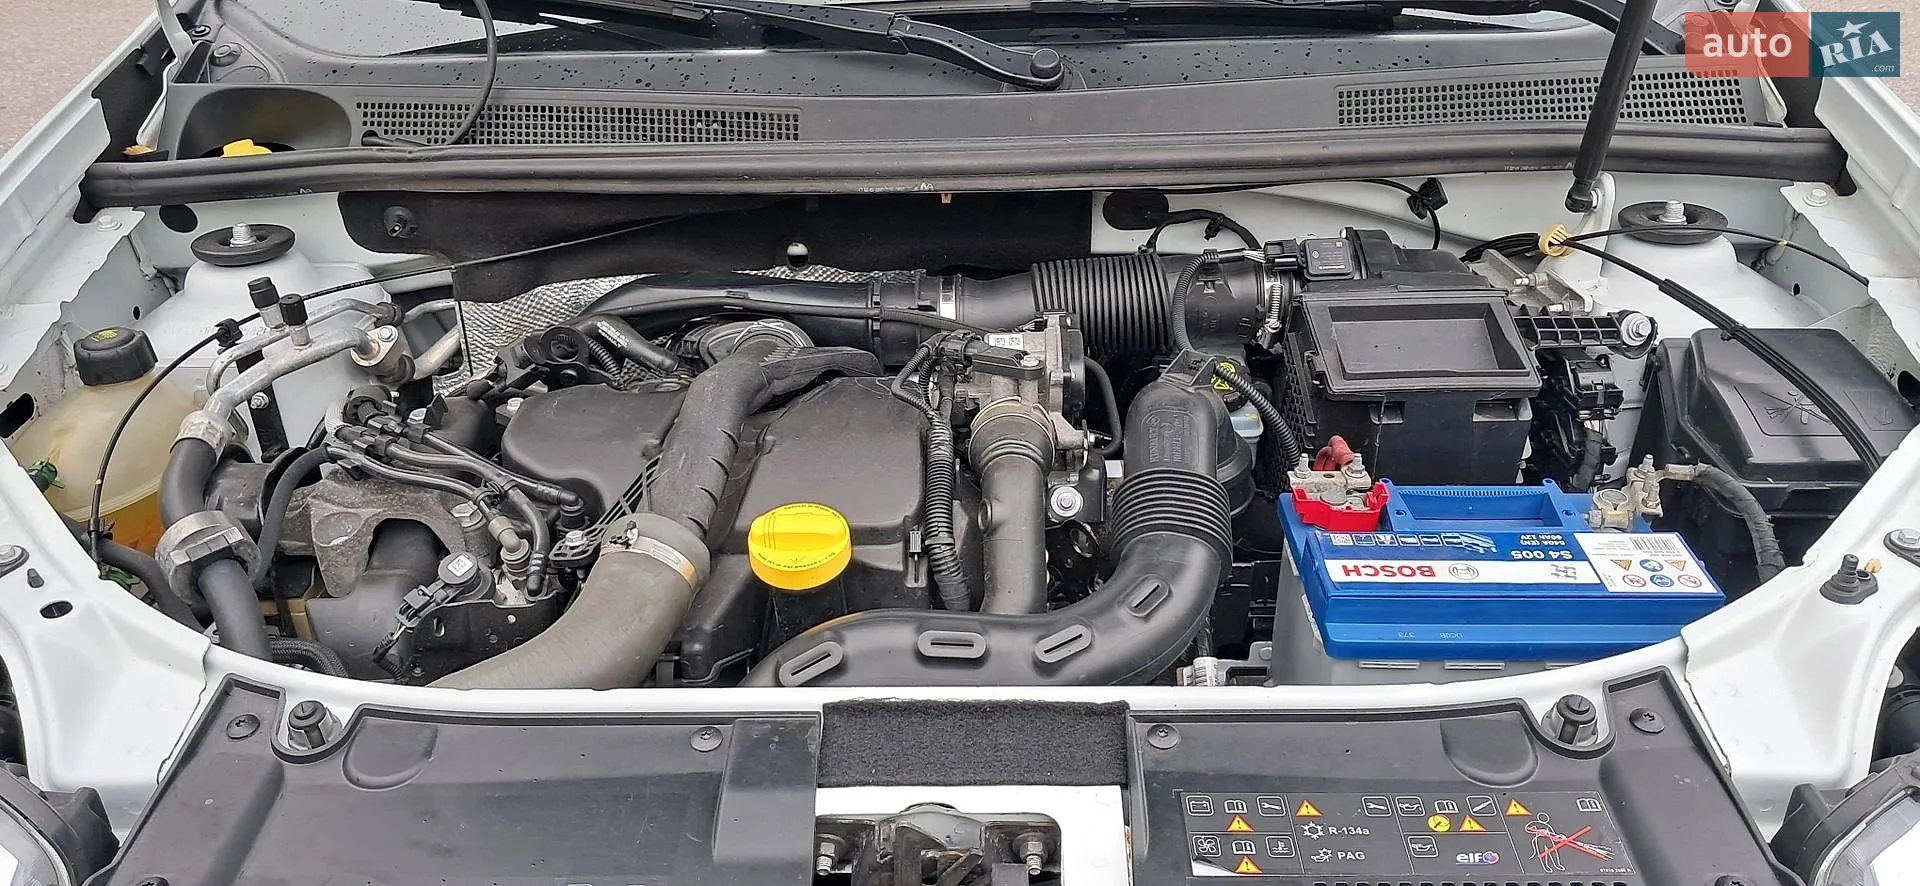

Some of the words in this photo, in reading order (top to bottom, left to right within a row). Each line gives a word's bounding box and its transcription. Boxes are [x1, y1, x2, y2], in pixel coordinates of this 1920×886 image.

[1511, 550, 1545, 560] 005
[1548, 550, 1573, 560] S4
[1341, 564, 1437, 579] BOSCH
[1328, 826, 1370, 835] R-134a
[1337, 851, 1366, 860] PAG
